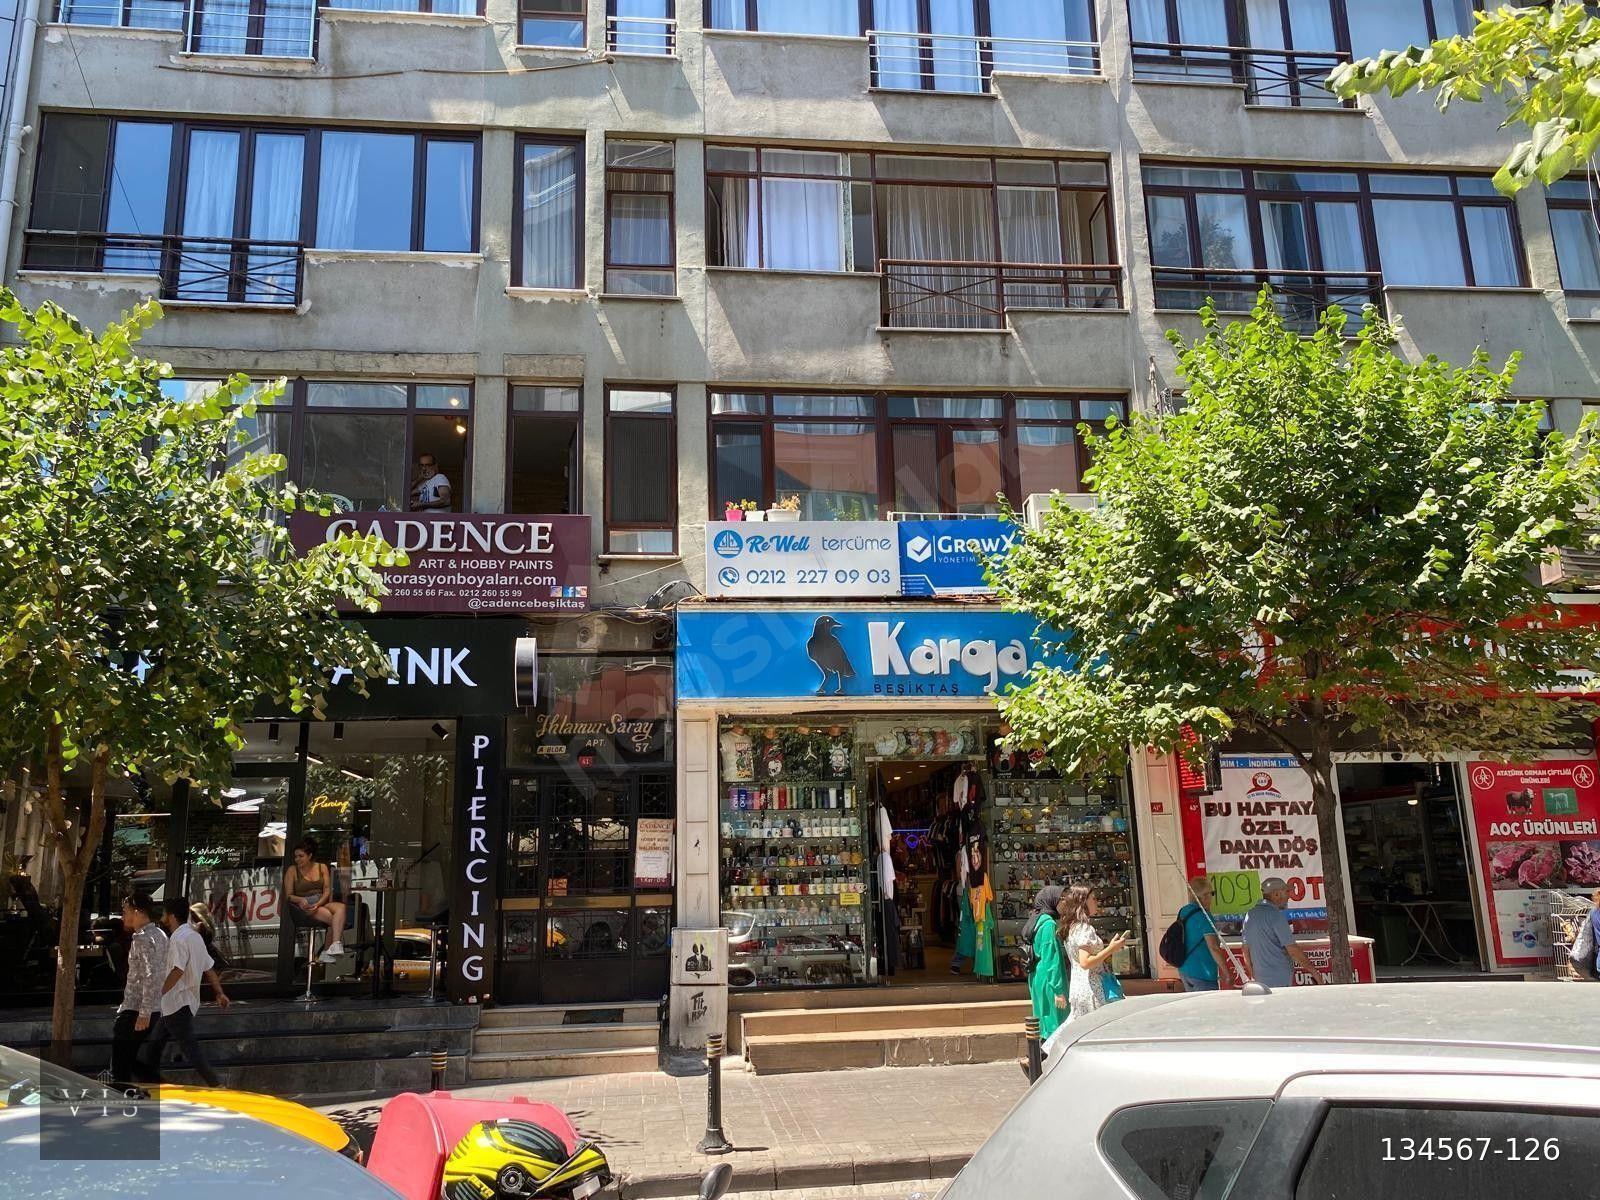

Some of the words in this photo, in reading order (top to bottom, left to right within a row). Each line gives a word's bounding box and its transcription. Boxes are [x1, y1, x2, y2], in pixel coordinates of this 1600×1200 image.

[325, 519, 555, 555] CADENCE
[822, 536, 891, 551] tercüme
[418, 559, 443, 570] ART
[449, 560, 456, 570] &
[460, 559, 506, 570] HOBBY
[509, 560, 553, 570] PAINTS
[379, 571, 557, 588] korasyonboyaları.com
[746, 569, 786, 584] 0212
[797, 569, 829, 583] 227
[835, 569, 860, 583] 09
[867, 569, 891, 583] 03
[395, 589, 411, 597] 260
[413, 589, 423, 597] 55
[425, 589, 436, 597] 66
[438, 589, 456, 597] Fax.
[459, 589, 480, 597] 0212
[481, 589, 498, 597] 260
[499, 589, 511, 597] 55
[512, 589, 523, 597] 99
[468, 598, 585, 610] @cadencebeşiktaş
[868, 621, 1028, 693] Karga
[874, 681, 959, 696] BEŞİKTAŞ
[605, 713, 654, 742] Saray
[635, 742, 649, 752] 57
[1496, 769, 1524, 777] ATATÜRK
[1204, 802, 1232, 817] BU
[1240, 818, 1294, 836] ÖZEL
[1489, 821, 1522, 838] AOÇ
[1523, 818, 1598, 836] ÜRÜNLERİ
[1220, 838, 1275, 854] DANA
[1278, 836, 1319, 856] DÖŞ
[461, 735, 490, 981] PIERCING
[1238, 854, 1304, 869] KIYMA
